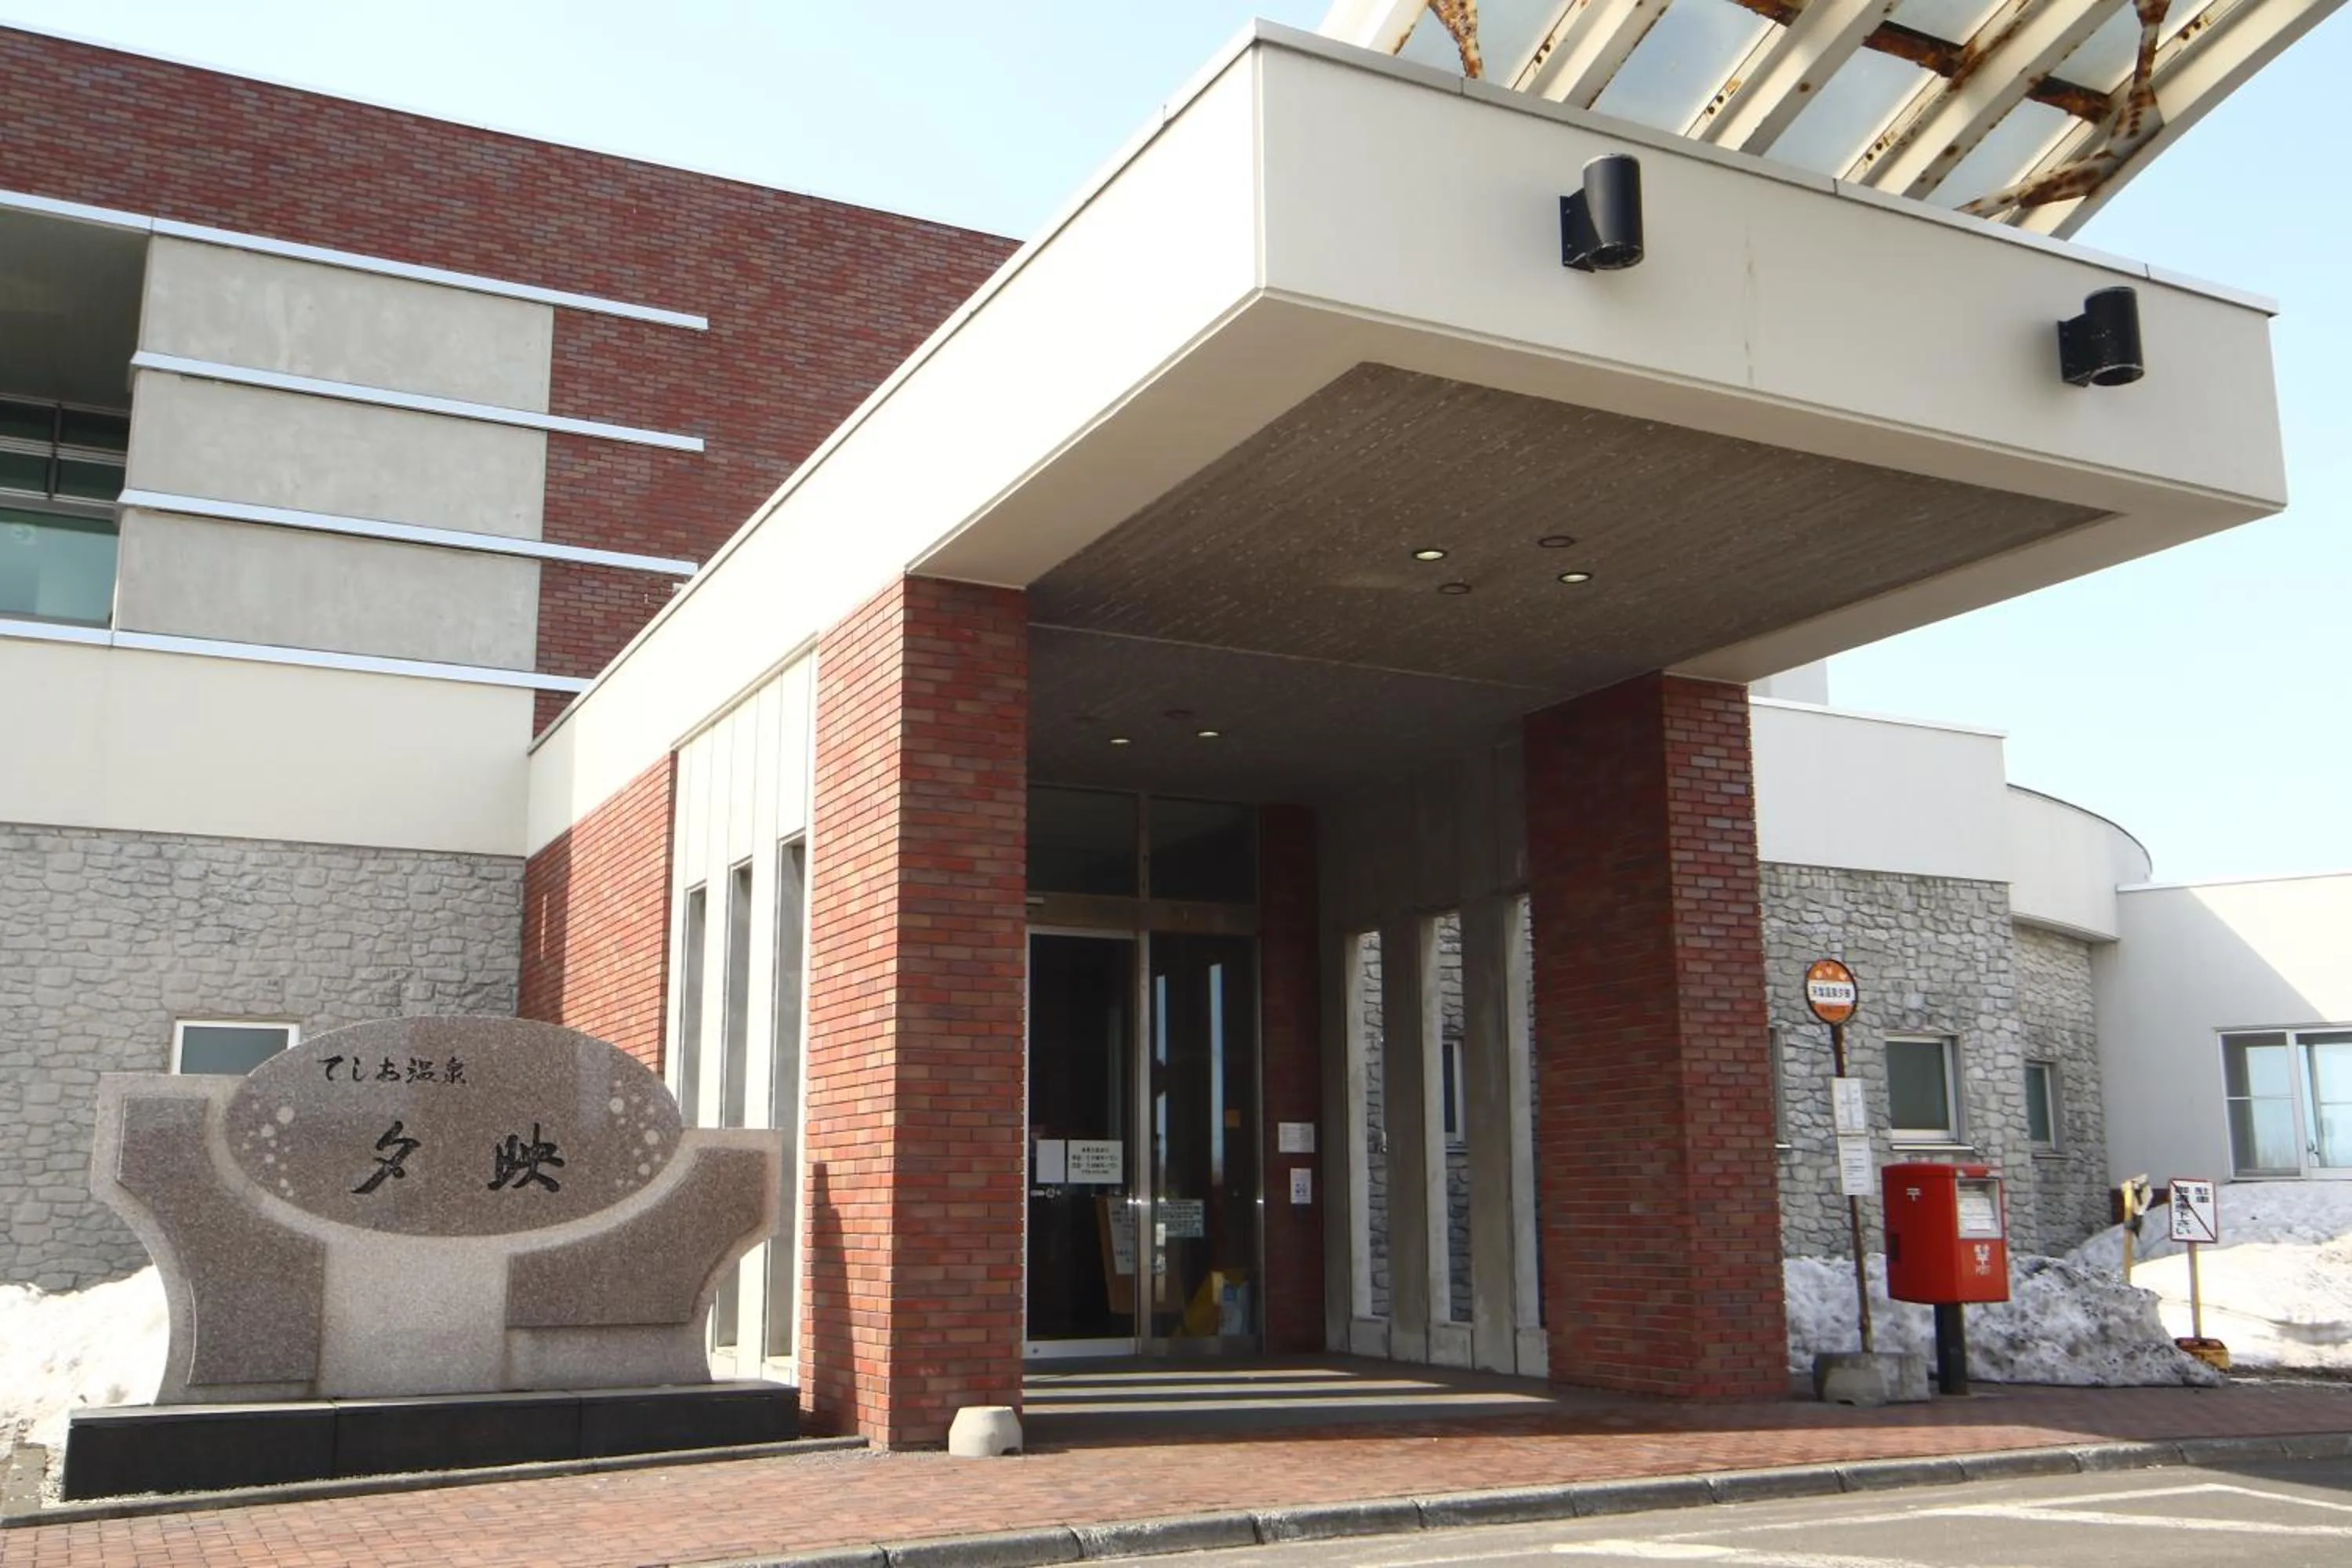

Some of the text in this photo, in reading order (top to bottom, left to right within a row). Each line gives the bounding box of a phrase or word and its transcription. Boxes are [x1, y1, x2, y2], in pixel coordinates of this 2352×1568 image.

[317, 1054, 467, 1085] てしお温泉
[350, 1120, 565, 1194] 夕映
